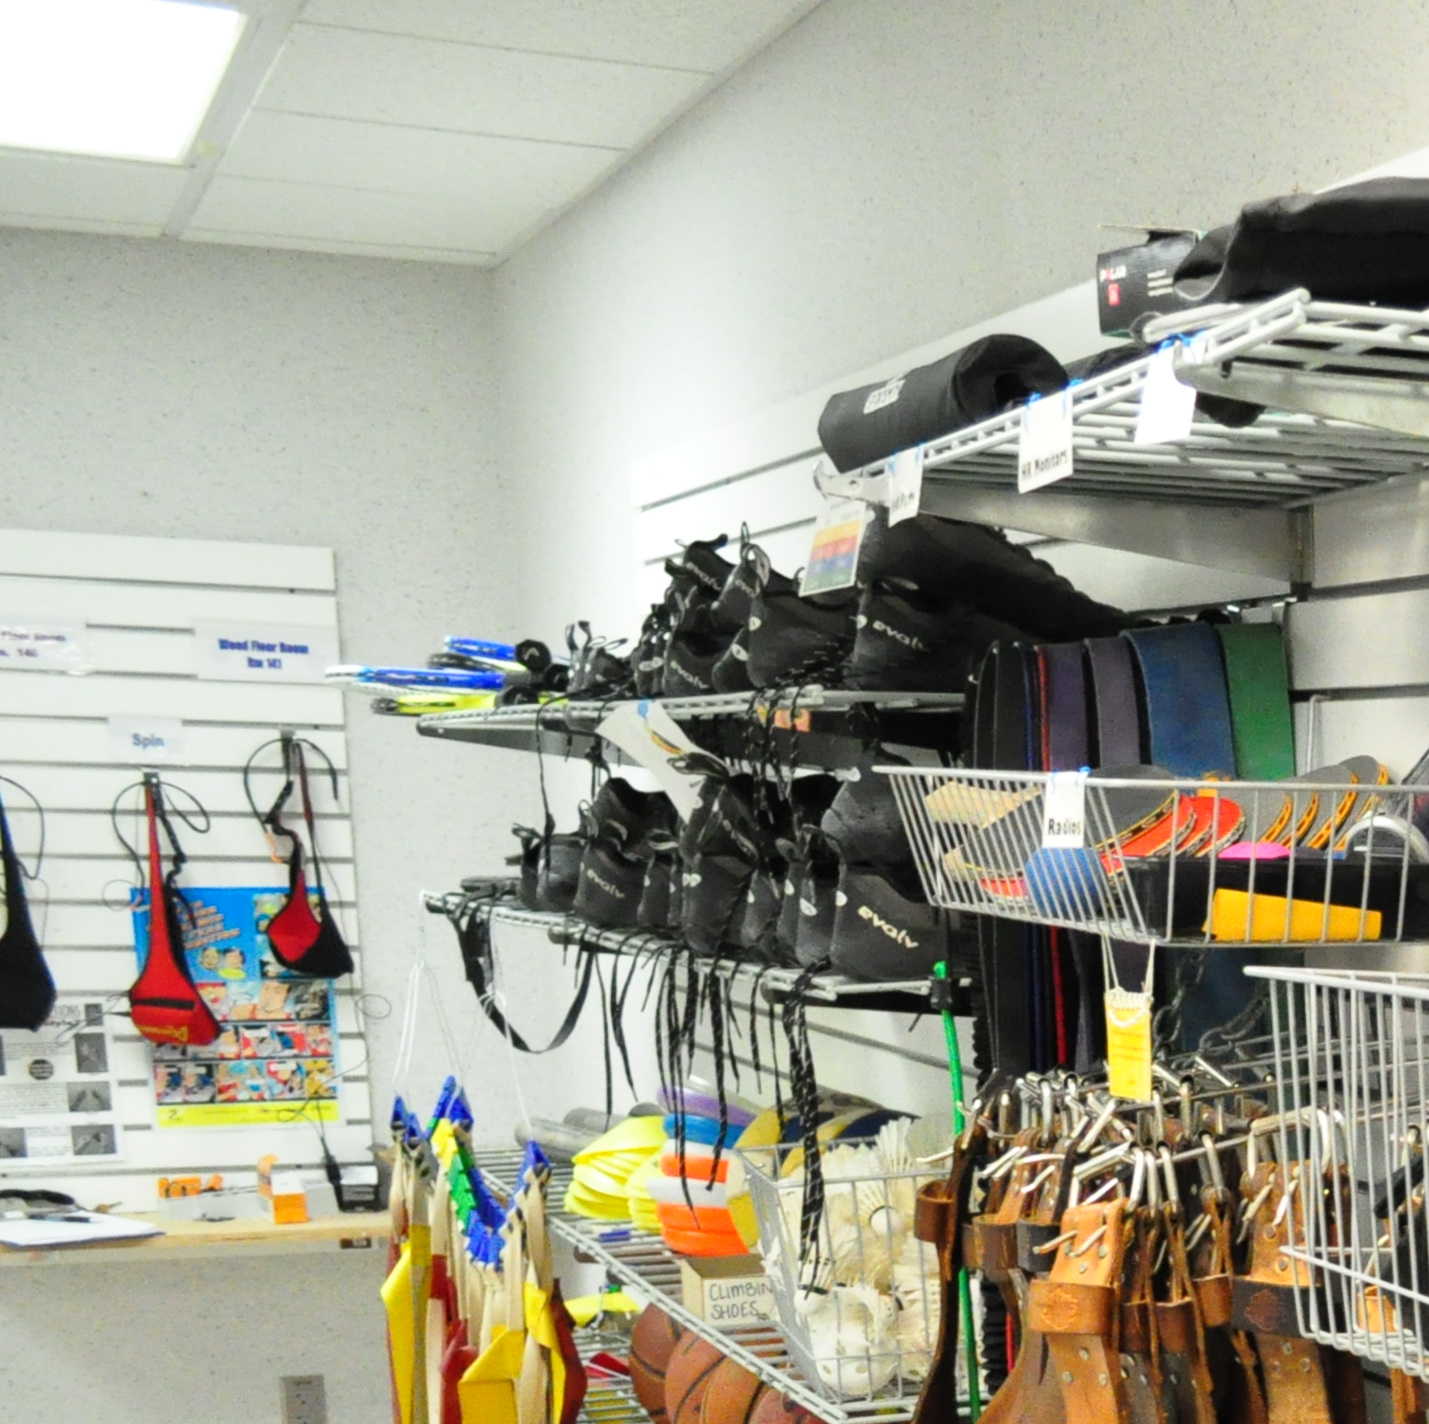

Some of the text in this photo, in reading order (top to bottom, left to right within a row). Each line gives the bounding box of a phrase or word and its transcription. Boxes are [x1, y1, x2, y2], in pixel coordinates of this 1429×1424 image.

[251, 640, 277, 653] Floor
[280, 642, 309, 654] Room
[132, 733, 164, 749] Spin
[1047, 816, 1082, 838] Radios
[709, 1281, 773, 1302] CLIMBIN
[711, 1300, 759, 1321] SHOES
